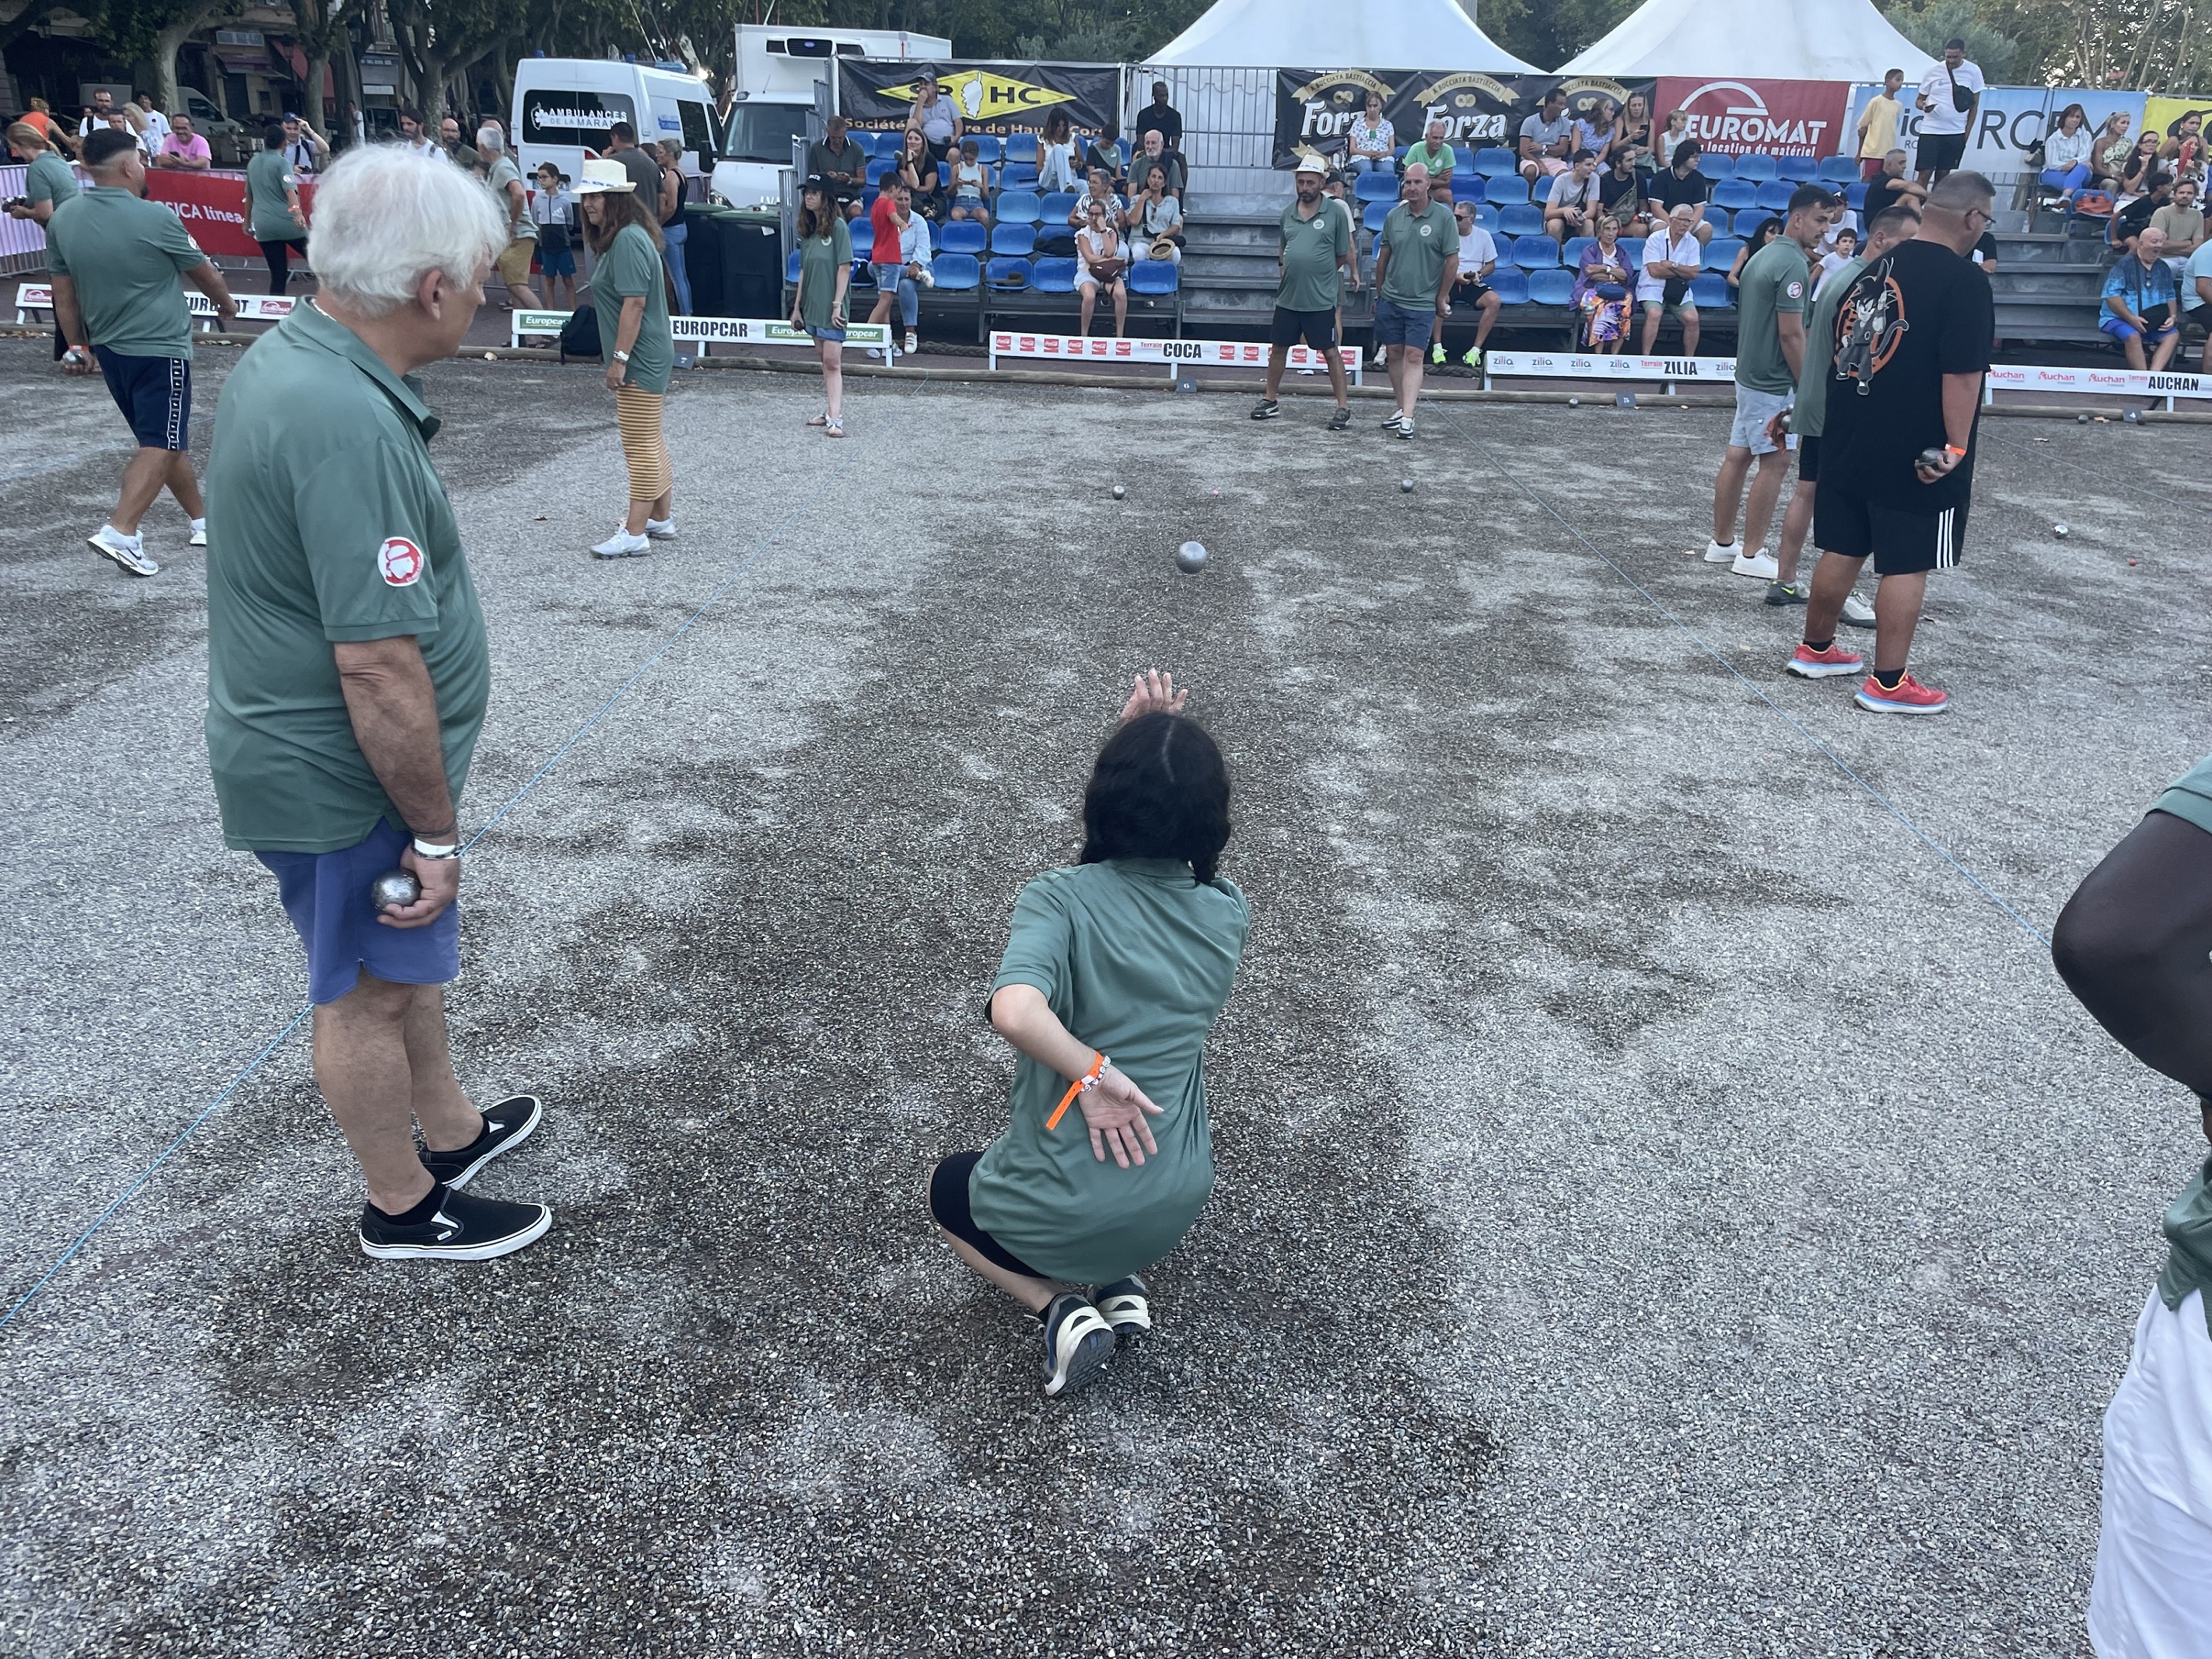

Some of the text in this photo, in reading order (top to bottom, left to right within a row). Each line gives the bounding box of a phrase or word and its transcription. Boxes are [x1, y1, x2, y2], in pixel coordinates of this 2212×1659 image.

[1345, 73, 1378, 89] BASTIACCIA
[1468, 76, 1501, 94] BASTIACCIA
[1591, 80, 1623, 96] BASTIACCIA
[990, 86, 1042, 104] HC
[549, 108, 627, 119] AMBULANCES
[577, 119, 616, 129] MARAN
[844, 118, 906, 130] Société
[986, 123, 1006, 134] de
[1011, 124, 1044, 135] Hau
[1070, 125, 1103, 137] Cors
[1421, 104, 1508, 140] Forza
[1685, 114, 1828, 145] EUROMAT
[1707, 140, 1752, 155] location
[1754, 144, 1768, 155] de
[1770, 144, 1816, 158] matériel
[526, 316, 565, 326] Europca
[673, 320, 748, 337] EUROPCAR
[1163, 343, 1202, 359] COCA
[1493, 356, 1514, 366] zilia
[1532, 357, 1553, 366] zilia
[1571, 358, 1591, 368] zilia
[1609, 359, 1630, 369] zilia
[1664, 362, 1698, 375] ZILIA
[2038, 371, 2074, 381] Auchan
[2088, 373, 2125, 384] Auchan
[2148, 376, 2200, 391] AUCHAN
